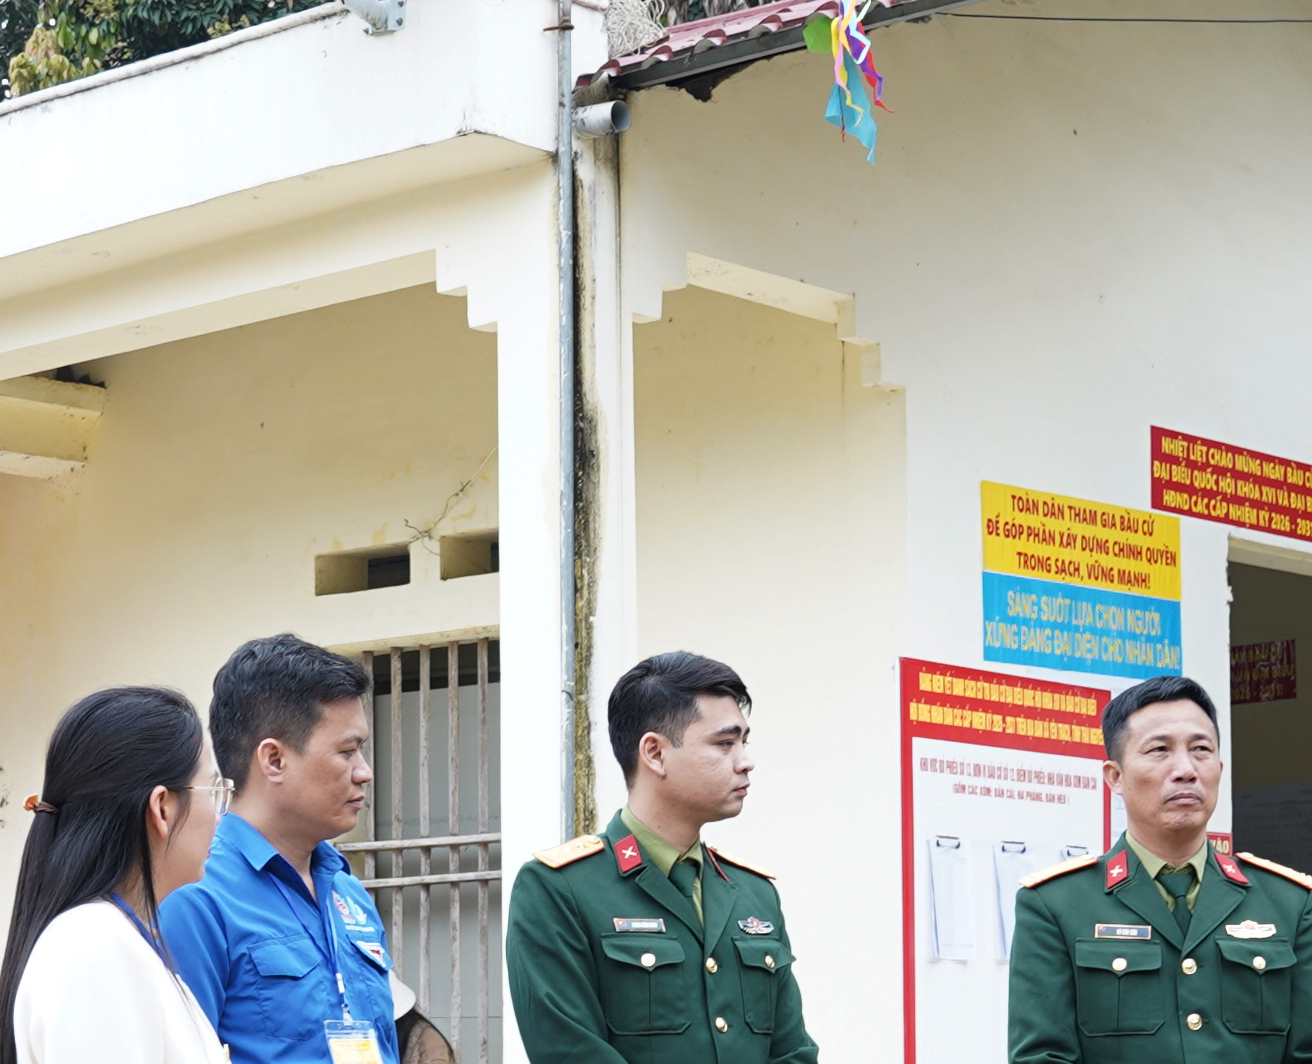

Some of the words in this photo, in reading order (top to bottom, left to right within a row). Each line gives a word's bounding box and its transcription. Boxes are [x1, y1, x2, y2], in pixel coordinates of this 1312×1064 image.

[1161, 436, 1188, 461] NHIỆT
[1189, 440, 1208, 466] LIỆT
[1208, 446, 1233, 469] CHÀO
[1235, 451, 1261, 475] MỪNG
[1262, 459, 1285, 482] NGÀY
[1287, 462, 1304, 487] BẦU
[1153, 461, 1170, 484] ĐẠI
[1171, 461, 1191, 484] BIỂU
[1192, 467, 1218, 491] QUỐC
[1218, 472, 1235, 498] HỘI
[1236, 478, 1260, 500] KHÓA
[1261, 486, 1276, 504] XVI
[1277, 486, 1289, 508] VÀ
[1290, 492, 1305, 514] ĐẠI
[1163, 489, 1189, 510] HĐND
[1191, 492, 1208, 515] CÁC
[1209, 495, 1228, 517] CẤP
[1229, 502, 1258, 527] NHIỆM
[1258, 506, 1270, 529] KỲ
[1271, 512, 1290, 532] 2026
[1010, 492, 1039, 516] TOÀN
[1043, 497, 1065, 521] DÂN
[1067, 505, 1098, 527] THAM
[1100, 511, 1118, 530] GIA
[1119, 509, 1139, 534] BẦU
[1142, 514, 1155, 537] CỬ
[986, 513, 1001, 537] ĐỂ
[1003, 518, 1024, 540] GÓP
[1026, 521, 1056, 548] PHẦN
[1058, 528, 1078, 552] XÂY
[1081, 537, 1110, 560] DỰNG
[1112, 536, 1143, 562] CHÍNH
[1145, 543, 1176, 568] QUYỀN
[1016, 552, 1052, 574] TRONG
[1054, 558, 1084, 582] SẠCH,
[1086, 561, 1114, 584] VỮNG
[1117, 570, 1151, 591] MẠNH!
